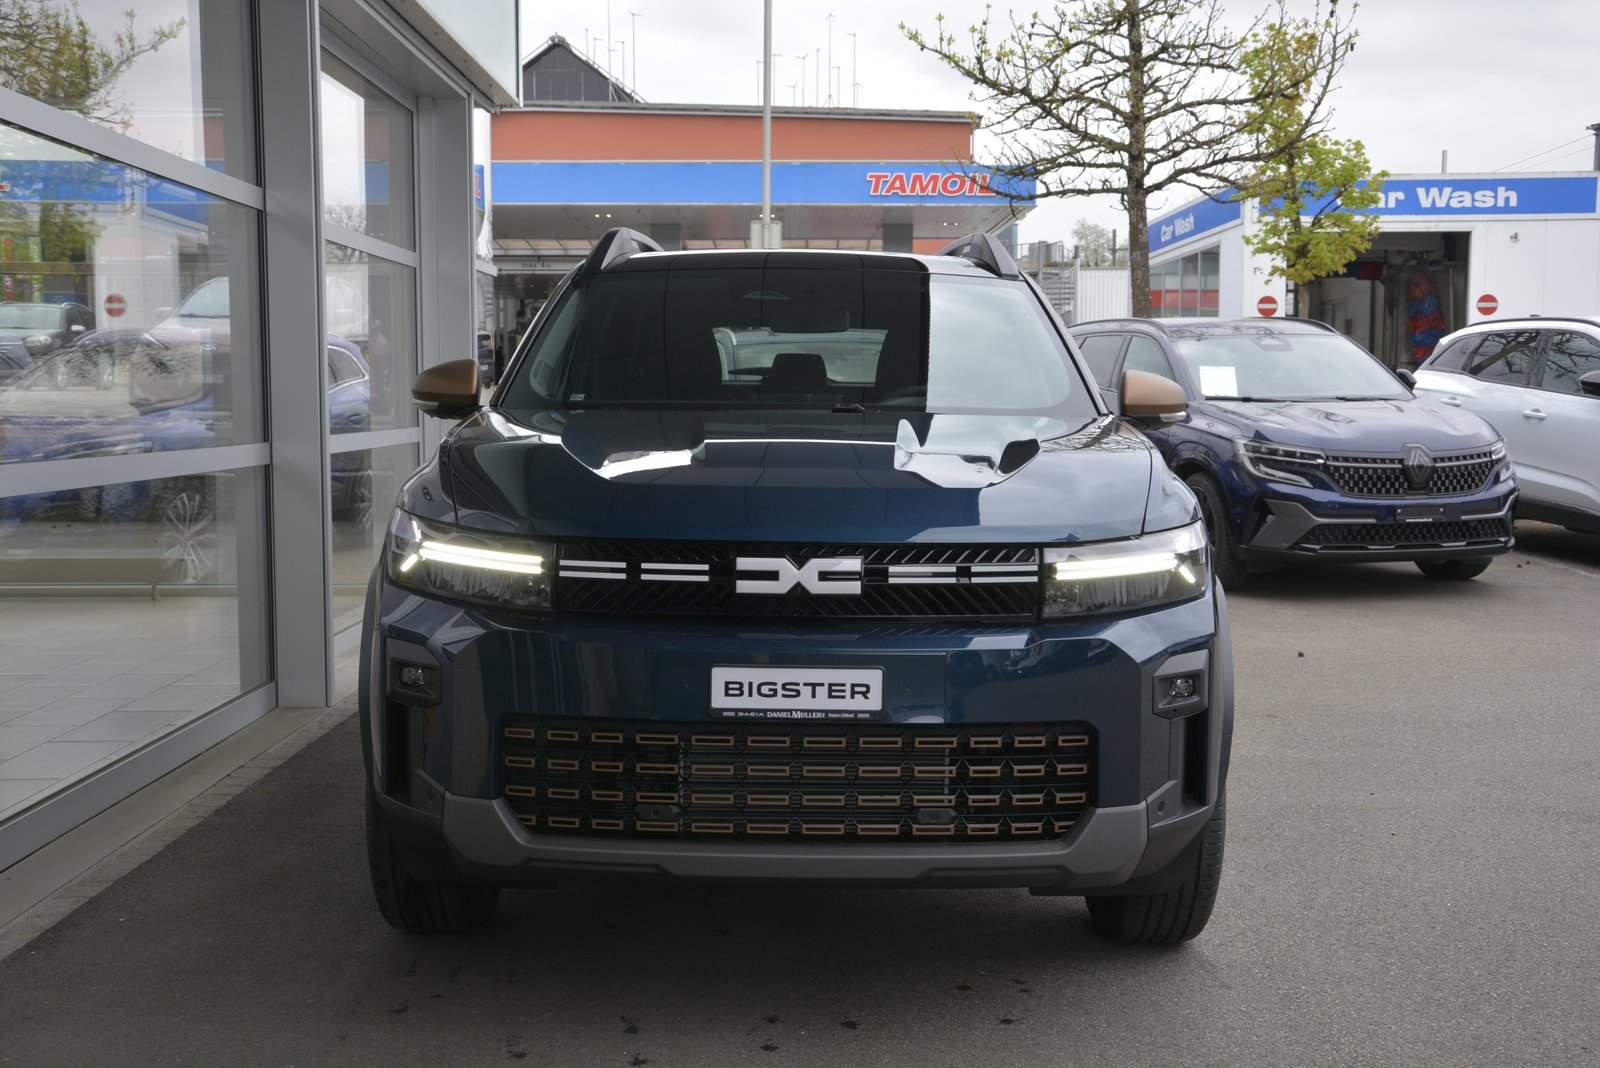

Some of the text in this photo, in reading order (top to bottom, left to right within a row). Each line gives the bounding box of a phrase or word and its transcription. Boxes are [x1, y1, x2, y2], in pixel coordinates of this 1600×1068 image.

[867, 172, 997, 196] TAMOIL
[1416, 186, 1518, 208] Wash
[1160, 212, 1195, 243] Car Wash
[724, 681, 871, 700] BIGSTER
